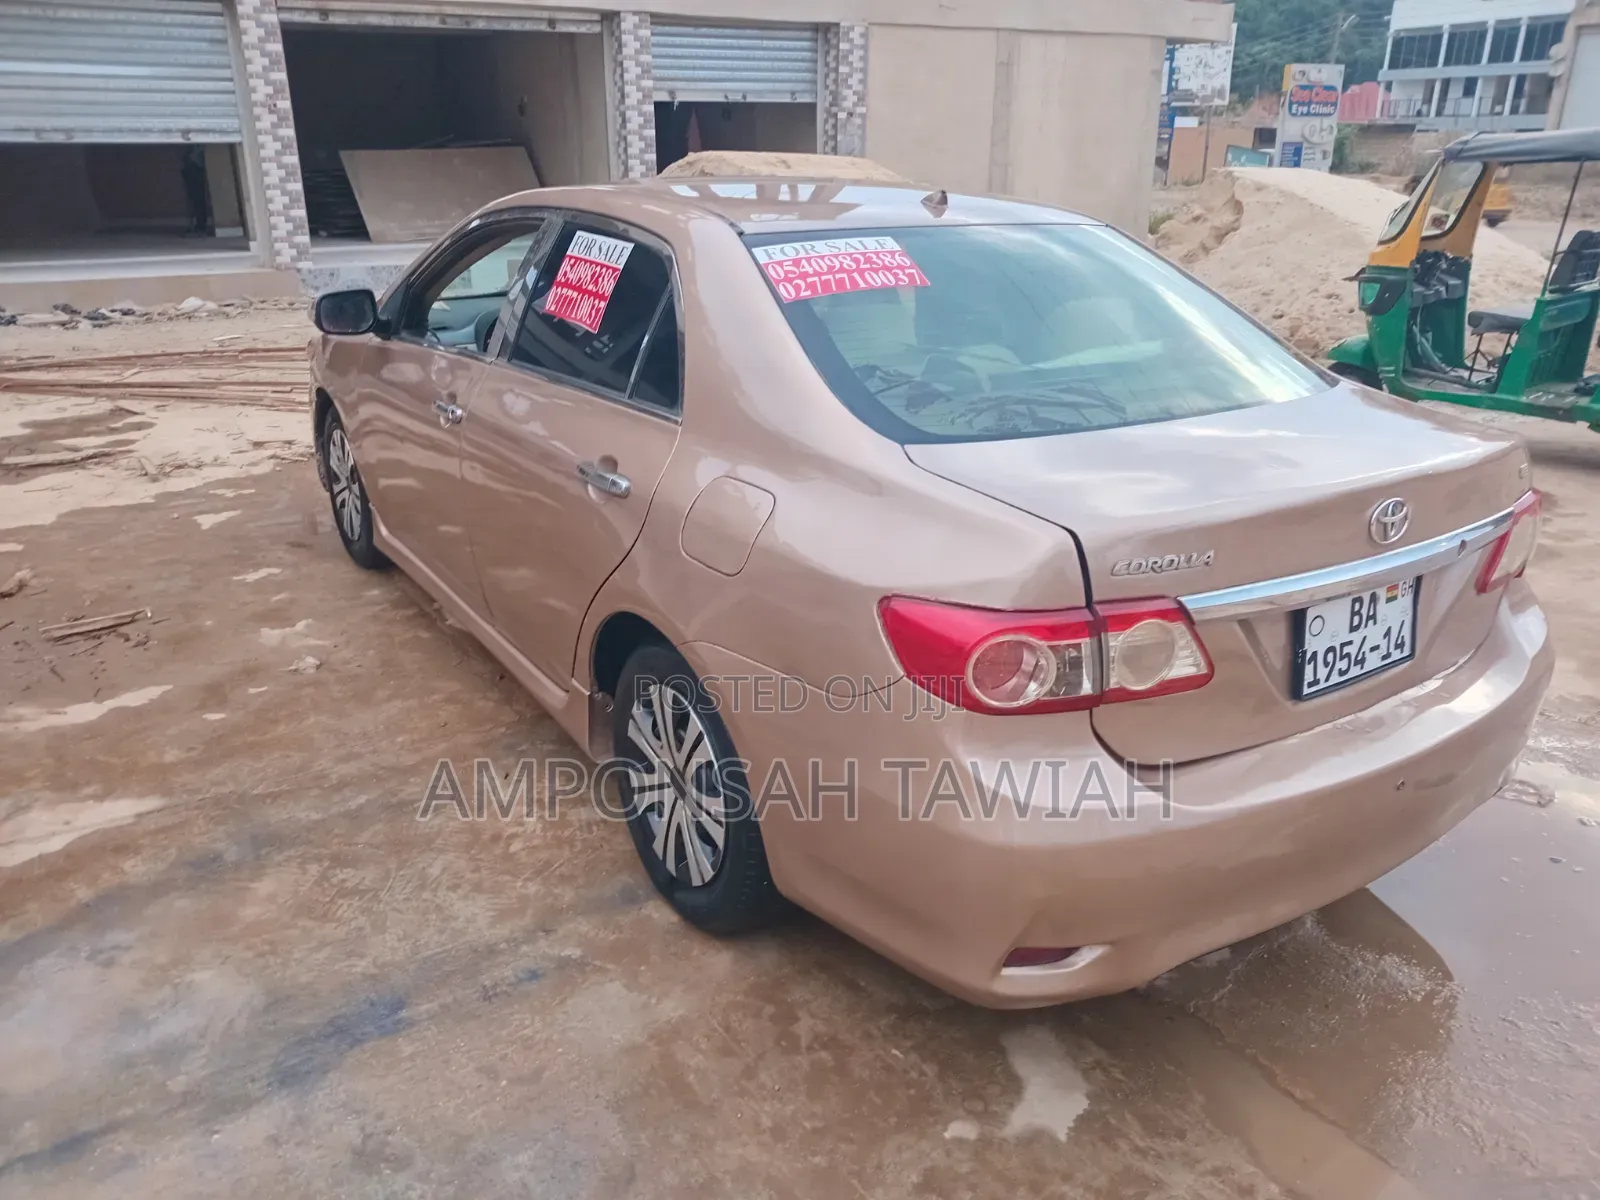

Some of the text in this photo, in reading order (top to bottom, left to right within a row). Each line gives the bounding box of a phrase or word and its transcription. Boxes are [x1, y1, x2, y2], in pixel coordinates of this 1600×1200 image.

[1291, 103, 1336, 115] Eye Clinic
[571, 235, 628, 266] FOR SALE
[763, 238, 894, 260] FOR SALE
[556, 256, 621, 297] 0540982386
[767, 251, 911, 280] 0540982386
[778, 268, 921, 300] 0277710037
[545, 285, 606, 329] 0277710037
[1110, 549, 1215, 576] COROLLA
[1349, 577, 1415, 634] BA GH
[1306, 619, 1406, 689] 1954-14
